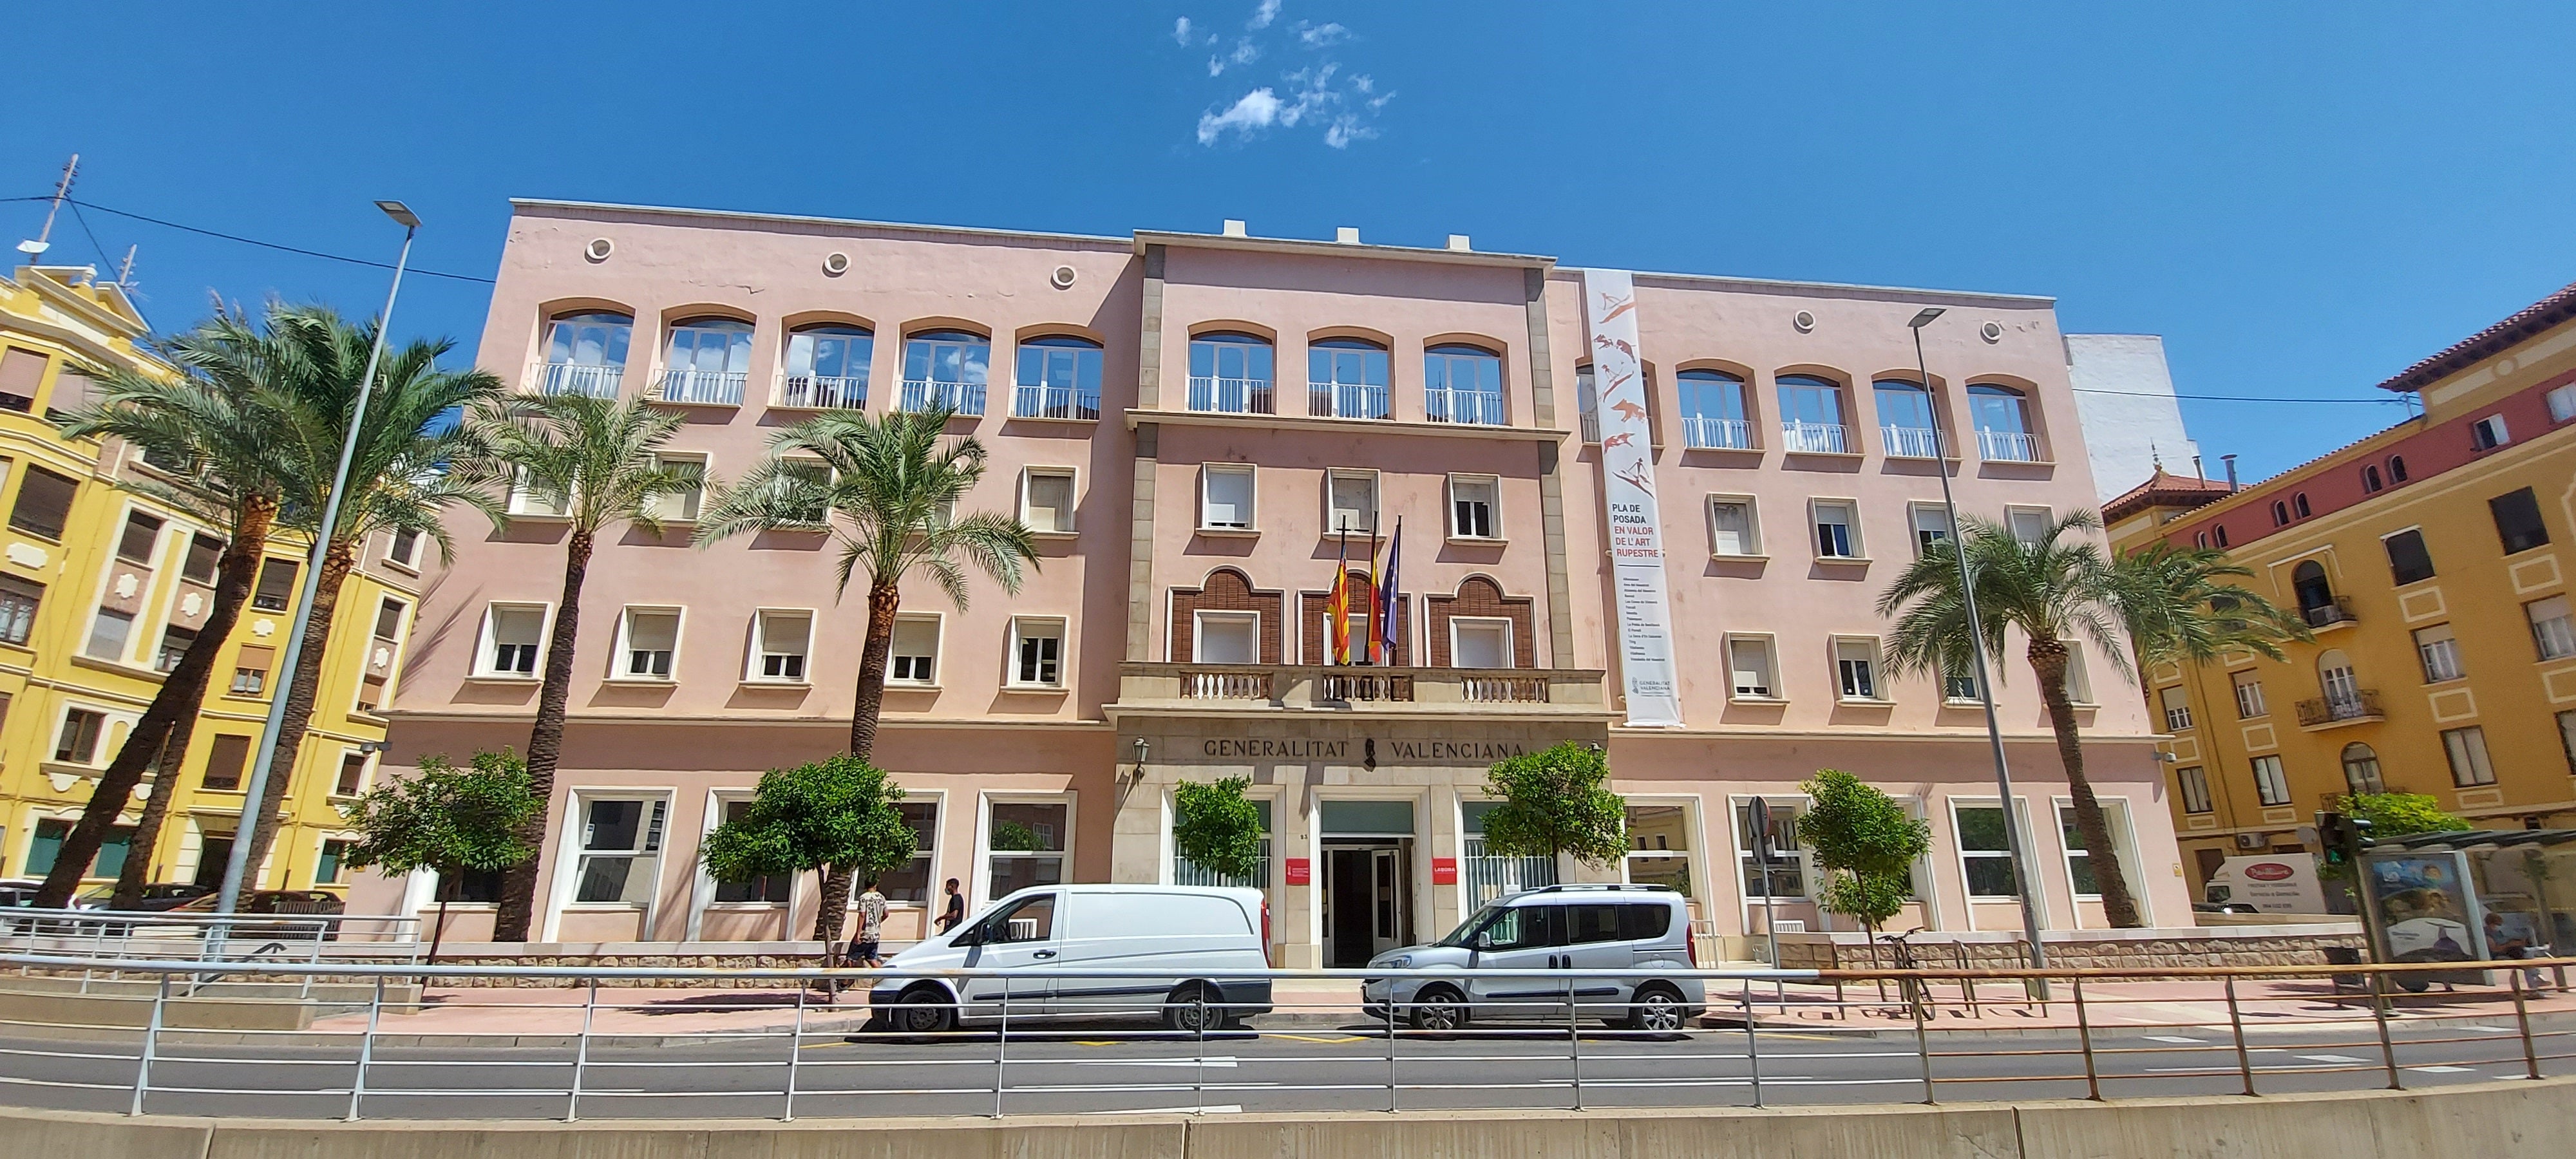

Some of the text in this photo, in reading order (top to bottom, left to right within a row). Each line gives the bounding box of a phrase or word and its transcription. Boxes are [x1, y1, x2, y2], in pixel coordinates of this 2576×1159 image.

[1613, 504, 1628, 513] PLA
[1613, 515, 1646, 523] POSADA
[1627, 527, 1654, 535] VALOR
[1616, 538, 1627, 546] DE
[1617, 549, 1658, 558] RUPESTRE
[1204, 739, 1524, 759] GENERALITAT VALENCIANA
